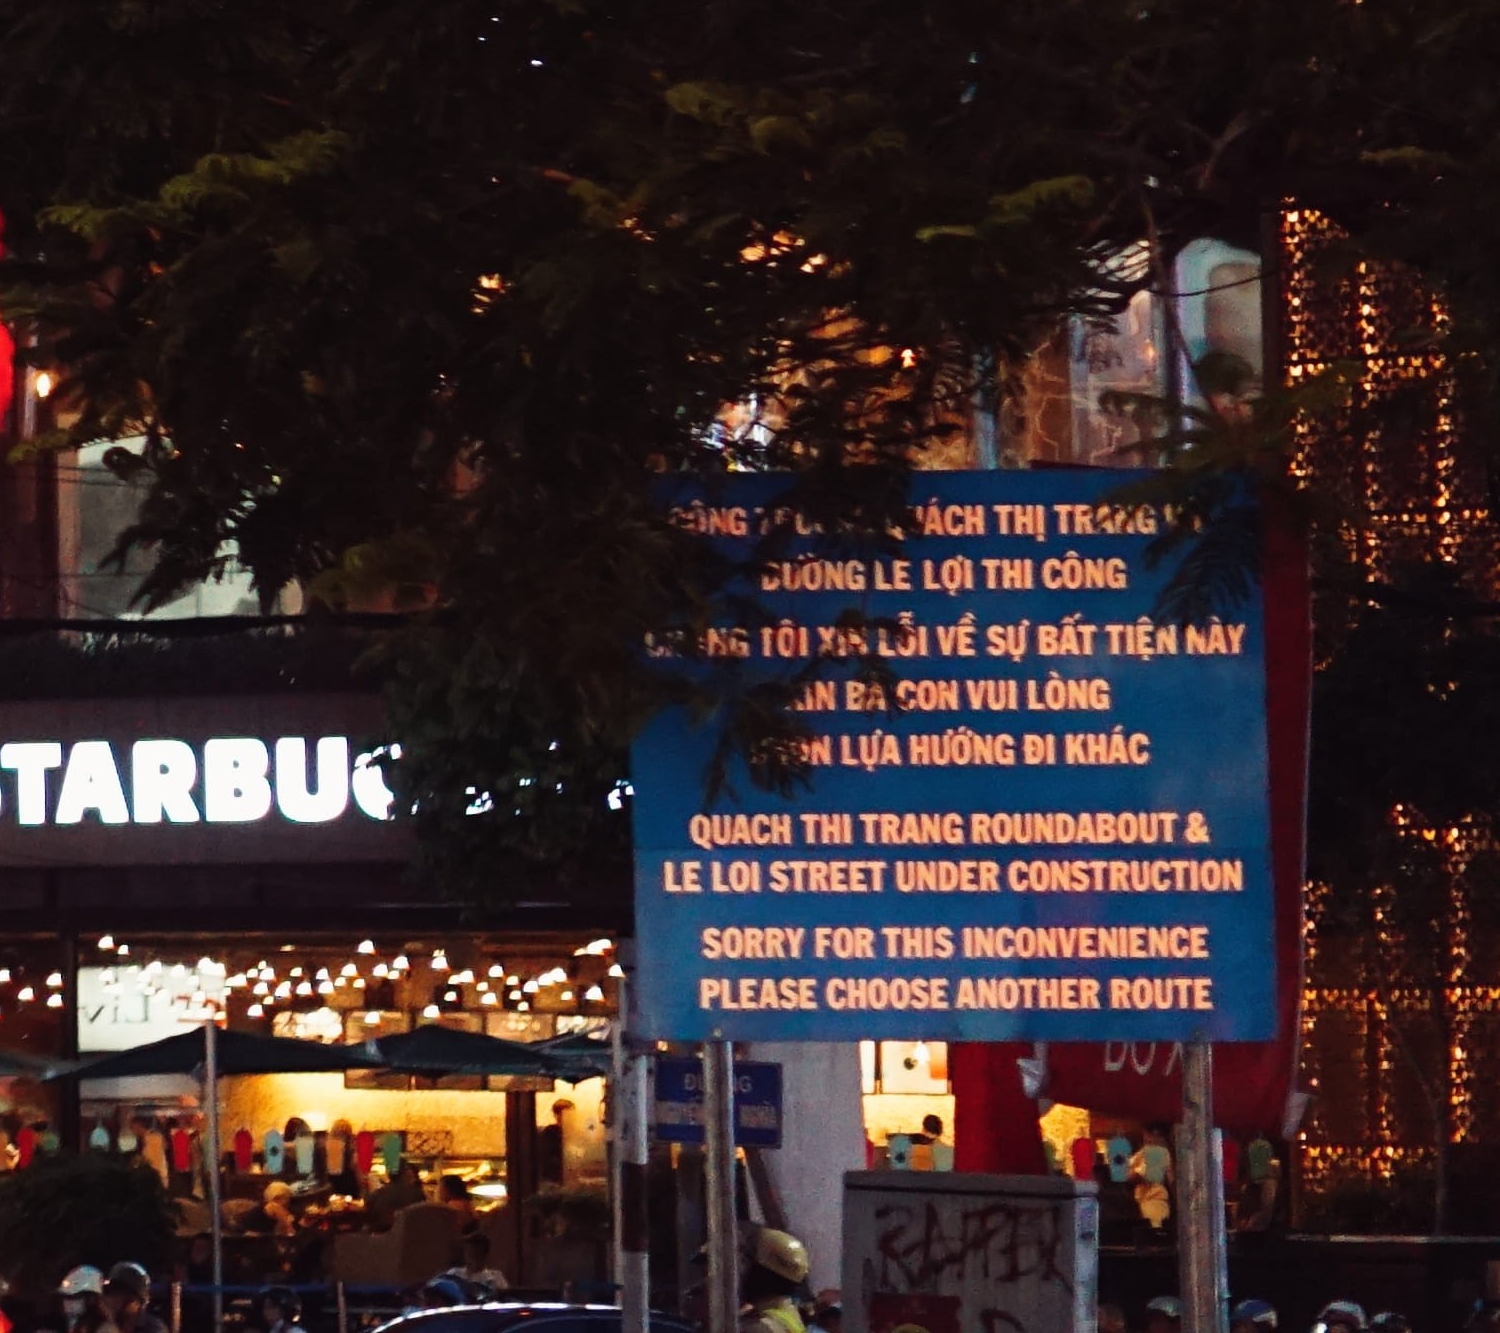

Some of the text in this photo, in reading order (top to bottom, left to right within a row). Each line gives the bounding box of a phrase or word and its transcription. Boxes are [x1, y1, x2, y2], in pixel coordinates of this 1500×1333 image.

[993, 503, 1048, 542] THỊ
[1054, 503, 1159, 535] TRANG
[923, 554, 974, 597] LỢI
[982, 559, 1033, 590] THI
[1042, 550, 1128, 590] CÔNG
[759, 618, 810, 658] TÔI
[936, 612, 976, 657] VỀ
[986, 618, 1031, 663] SỰ
[1036, 612, 1098, 656] BẤT
[1104, 616, 1178, 662] TIỆN
[1186, 615, 1246, 656] NÀY
[896, 681, 960, 712] CON
[966, 680, 1018, 711] VUI
[1027, 670, 1111, 711] LÒNG
[841, 729, 901, 772] LỰA
[908, 726, 1016, 766] HƯỚNG
[1023, 735, 1056, 765] ĐI
[1064, 724, 1151, 765] KHÁC
[689, 812, 1211, 851] QUACH THI TRANG ROUNDABOUT &
[663, 860, 1244, 893] LE LOI STREET UNDER CONSTRUCTION
[702, 927, 1211, 960] SORRY FOR THIS INCONVENIENCE
[700, 978, 1214, 1010] PLEASE CHOOSE ANOTHER ROUTE
